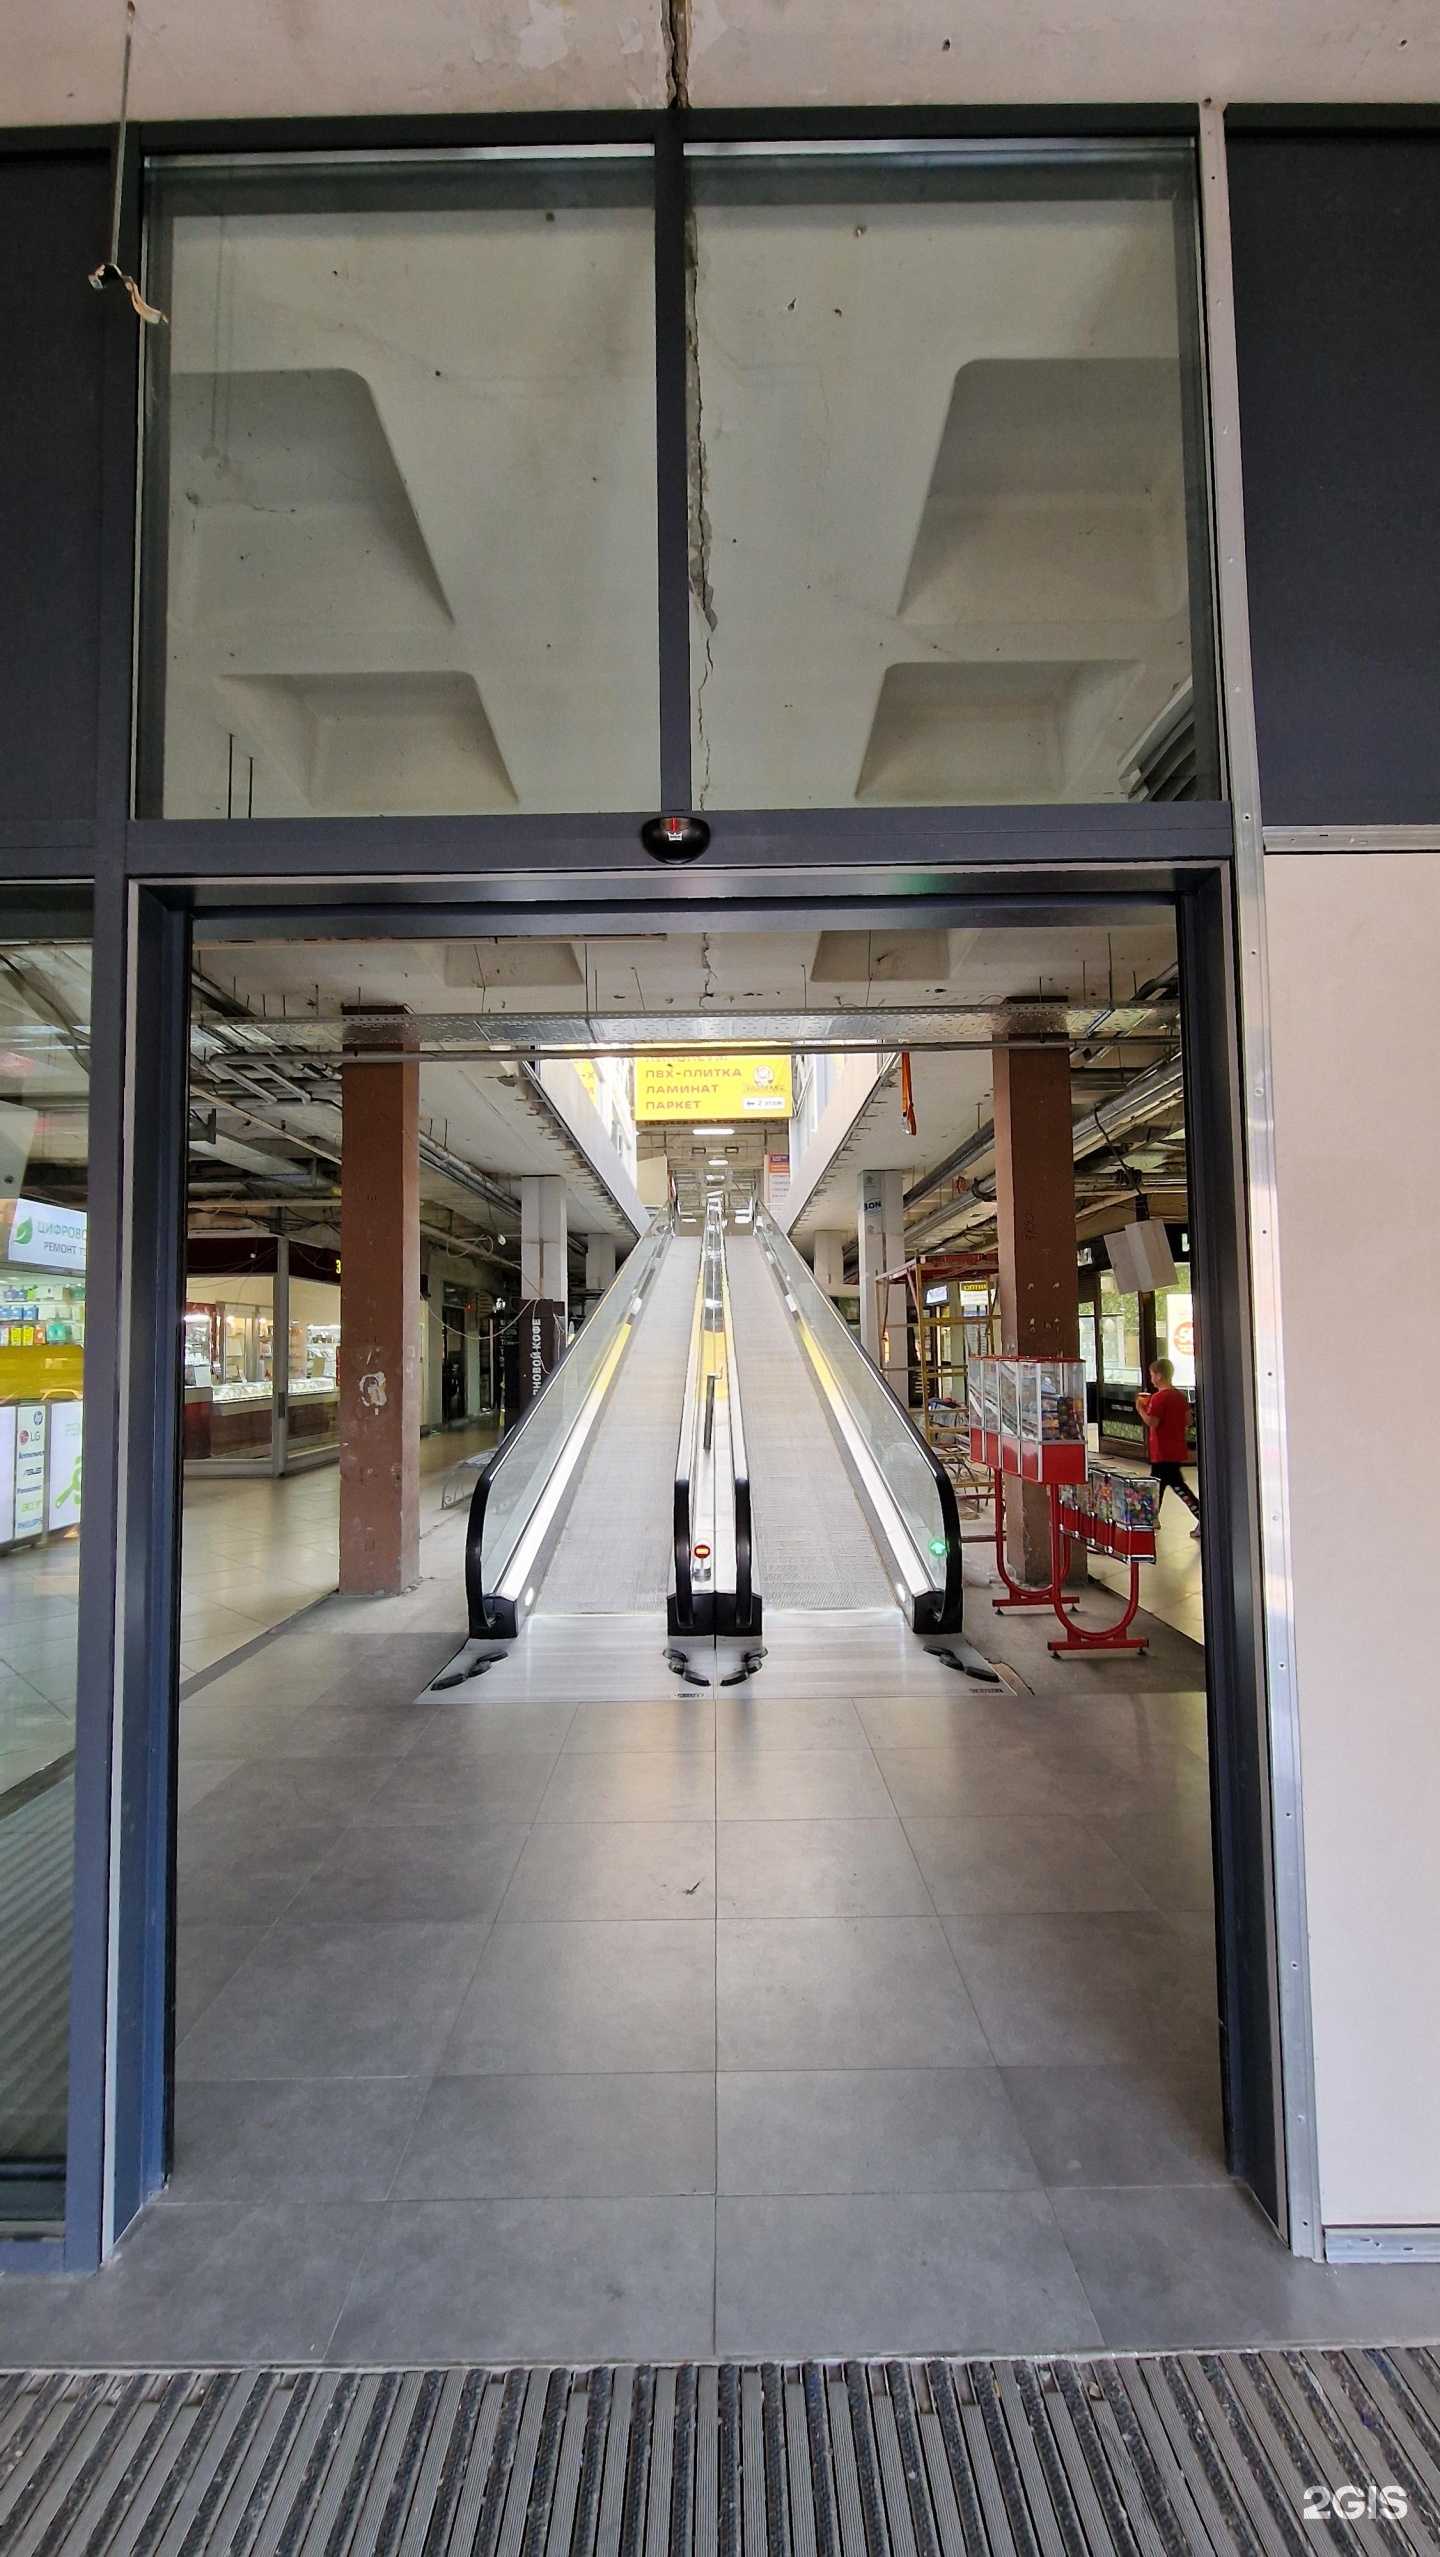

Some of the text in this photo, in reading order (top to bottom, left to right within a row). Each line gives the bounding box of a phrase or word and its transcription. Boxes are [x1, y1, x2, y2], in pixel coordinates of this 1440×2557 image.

[646, 1068, 742, 1079] ПВХ-ПЛИТКА
[646, 1084, 719, 1095] ЛАМИНАТ
[646, 1100, 702, 1110] ПАРКЕТ
[44, 1241, 77, 1255] РЕМОНТ
[531, 1318, 541, 1349] КОФЕ
